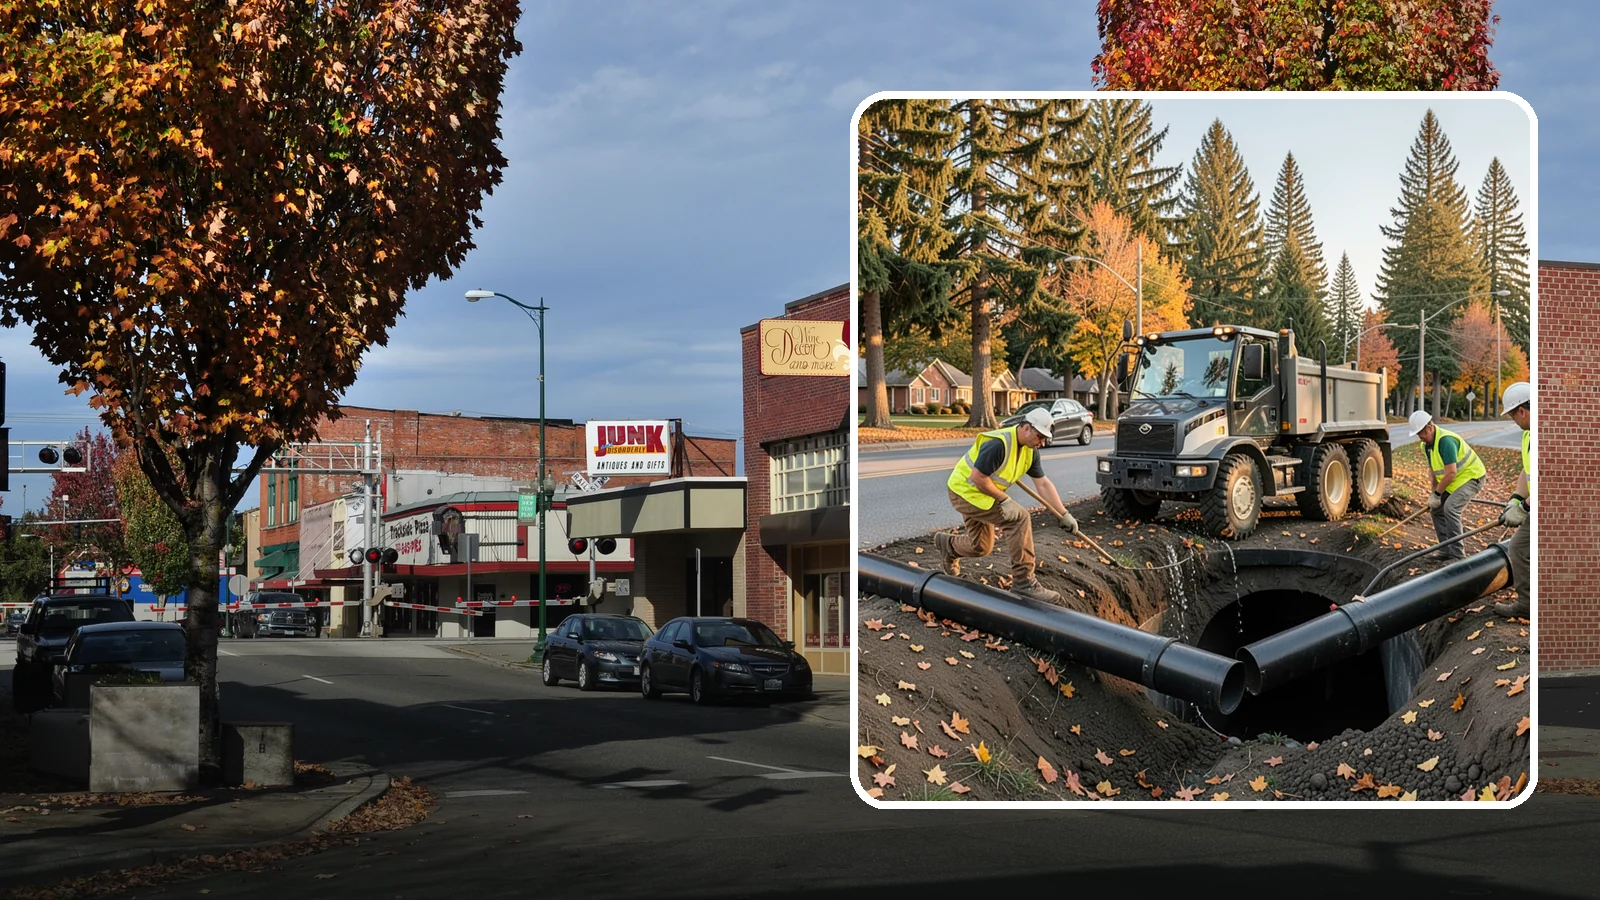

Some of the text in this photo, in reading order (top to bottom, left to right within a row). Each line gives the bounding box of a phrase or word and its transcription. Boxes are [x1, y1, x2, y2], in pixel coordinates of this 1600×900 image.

[596, 425, 665, 457] JUNK
[607, 446, 646, 454] DISORDERLY
[597, 460, 665, 470] ANTIQUES AND GIFTS
